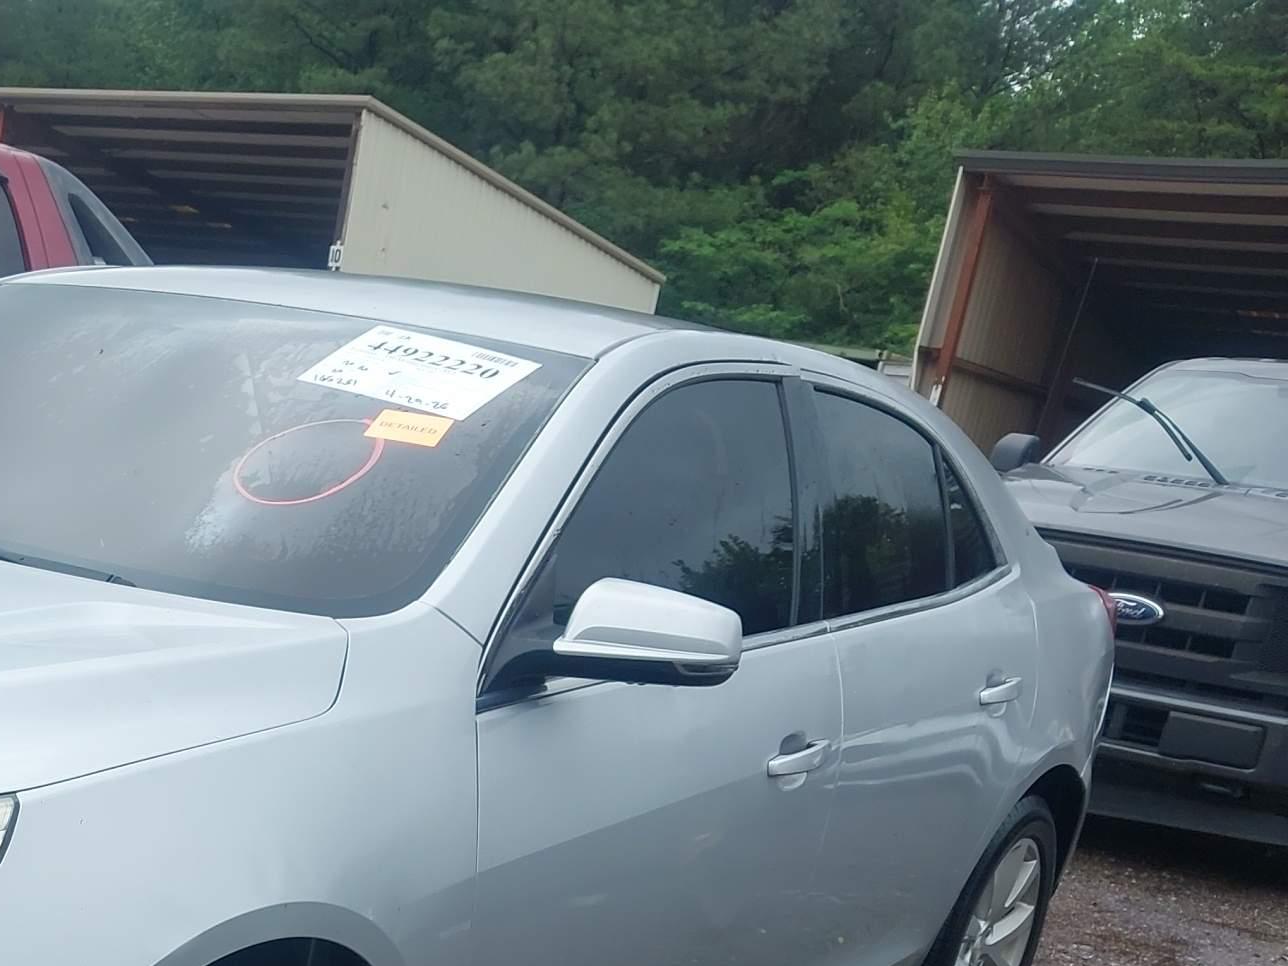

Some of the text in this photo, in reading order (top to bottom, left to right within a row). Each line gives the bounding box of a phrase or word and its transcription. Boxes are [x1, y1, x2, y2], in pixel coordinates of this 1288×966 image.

[330, 248, 342, 264] 10
[367, 340, 500, 380] 44922220
[378, 420, 438, 436] DETAILED
